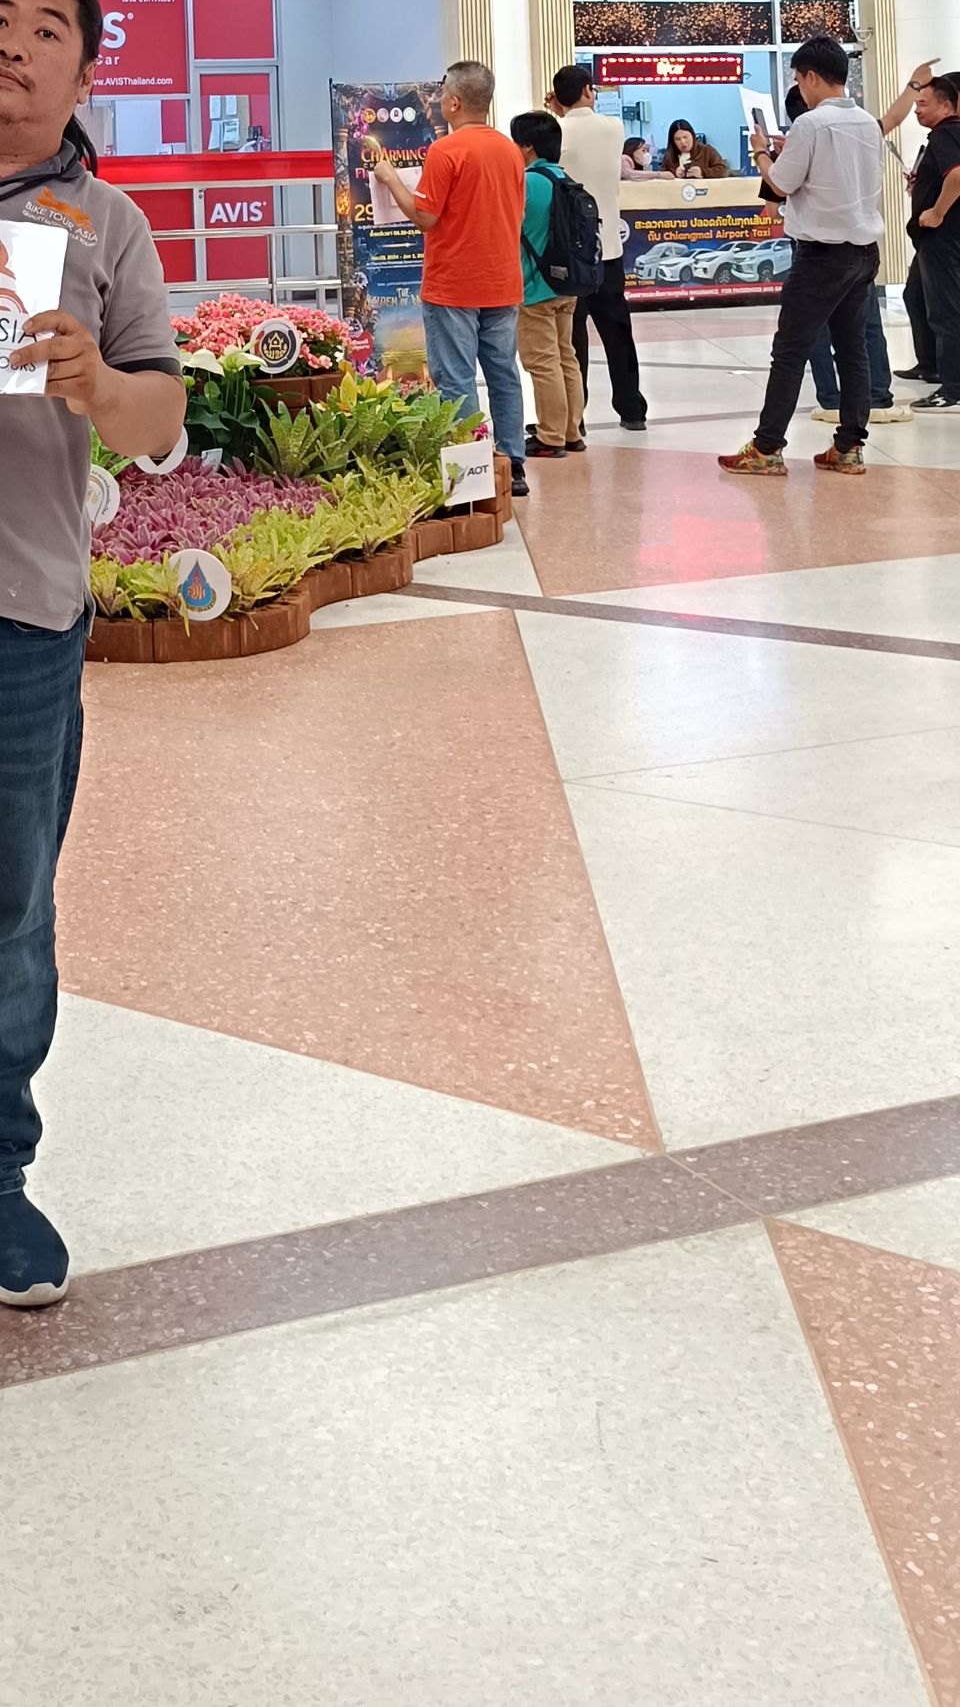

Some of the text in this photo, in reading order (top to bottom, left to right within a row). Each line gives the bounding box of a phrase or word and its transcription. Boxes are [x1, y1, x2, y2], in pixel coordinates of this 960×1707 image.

[25, 201, 98, 242] BIKE TOUR ASIA
[663, 230, 713, 242] Chiangmai
[715, 228, 749, 241] Airport
[752, 227, 771, 238] Taxi
[466, 464, 489, 477] AOT
